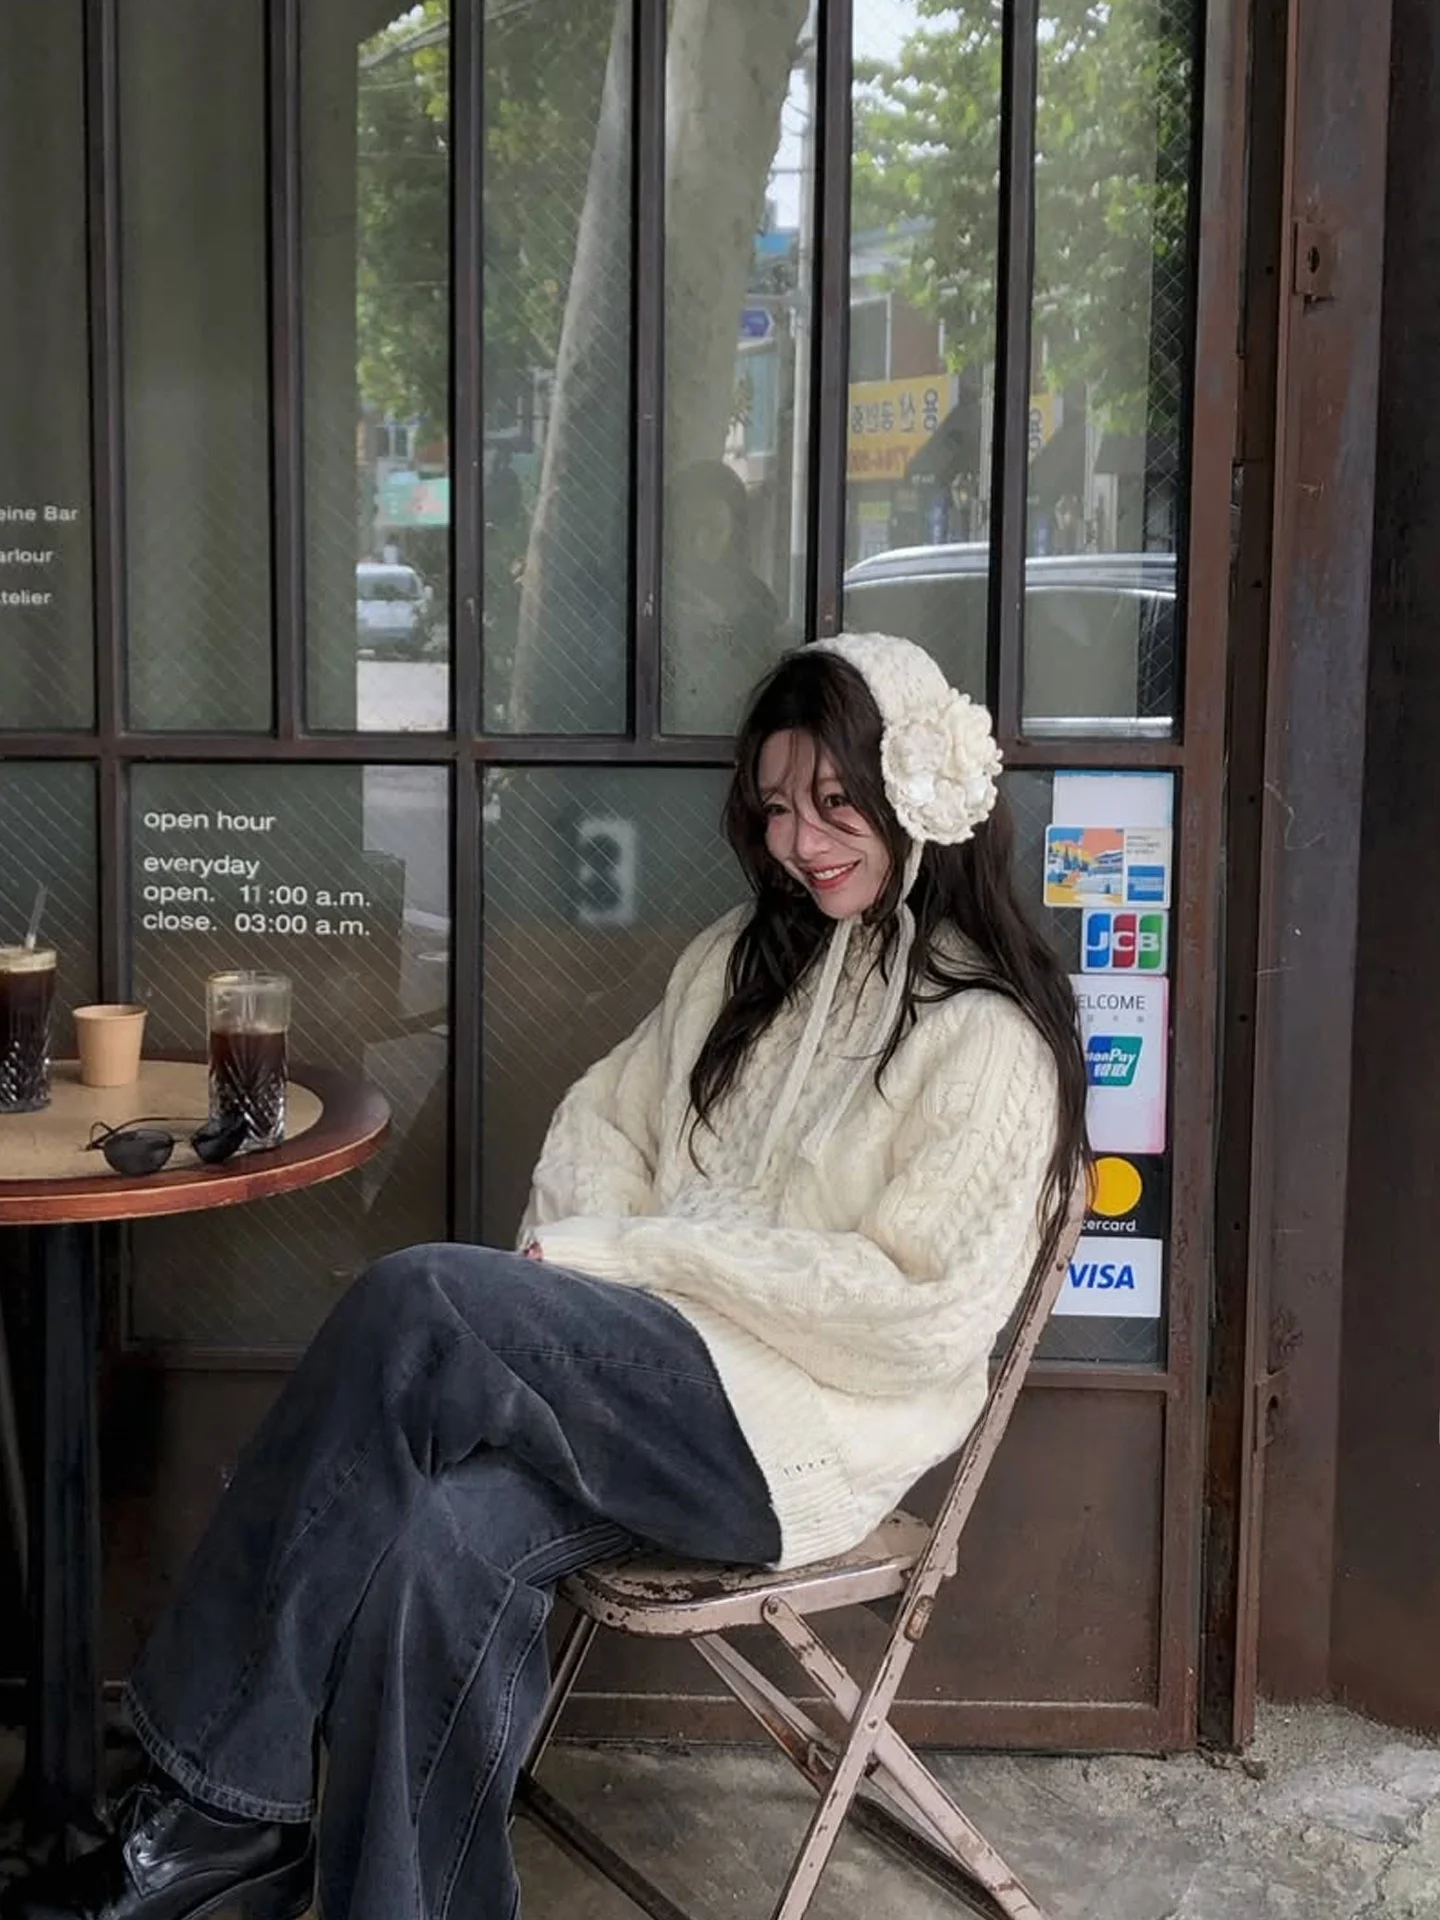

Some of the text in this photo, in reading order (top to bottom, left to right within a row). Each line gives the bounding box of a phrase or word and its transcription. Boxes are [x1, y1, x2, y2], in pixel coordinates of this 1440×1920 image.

[44, 504, 78, 521] Bar
[0, 590, 52, 605] telier
[144, 811, 276, 832] open hour
[144, 855, 260, 878] everyday
[144, 886, 215, 907] open.
[316, 889, 371, 908] a.m.
[144, 911, 371, 935] close. 03:00 a.m.
[1074, 993, 1146, 1010] ELCOME
[1069, 1264, 1134, 1289] VISA
